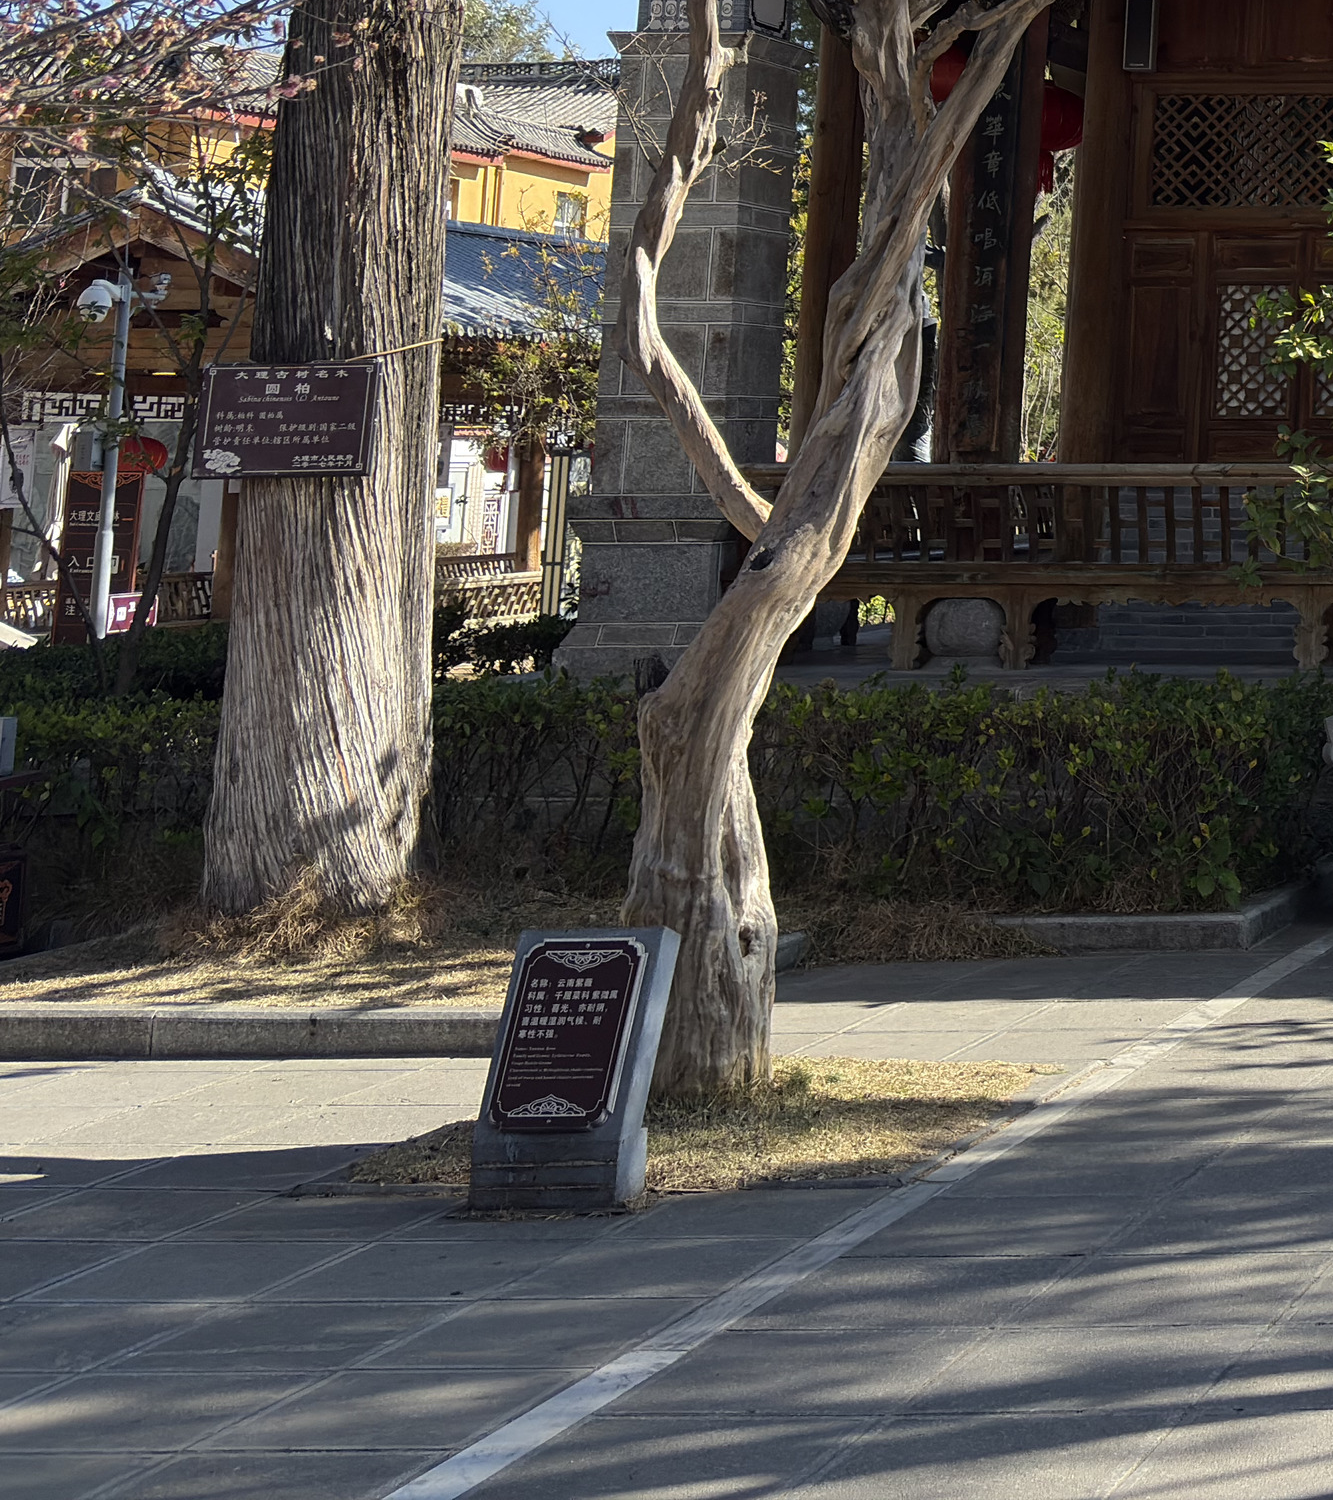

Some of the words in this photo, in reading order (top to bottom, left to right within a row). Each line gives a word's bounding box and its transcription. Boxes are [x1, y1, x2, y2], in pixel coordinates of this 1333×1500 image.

[234, 370, 349, 380] 大理古树名木
[265, 383, 311, 395] 圆柏
[292, 454, 354, 462] 大理市人民政府
